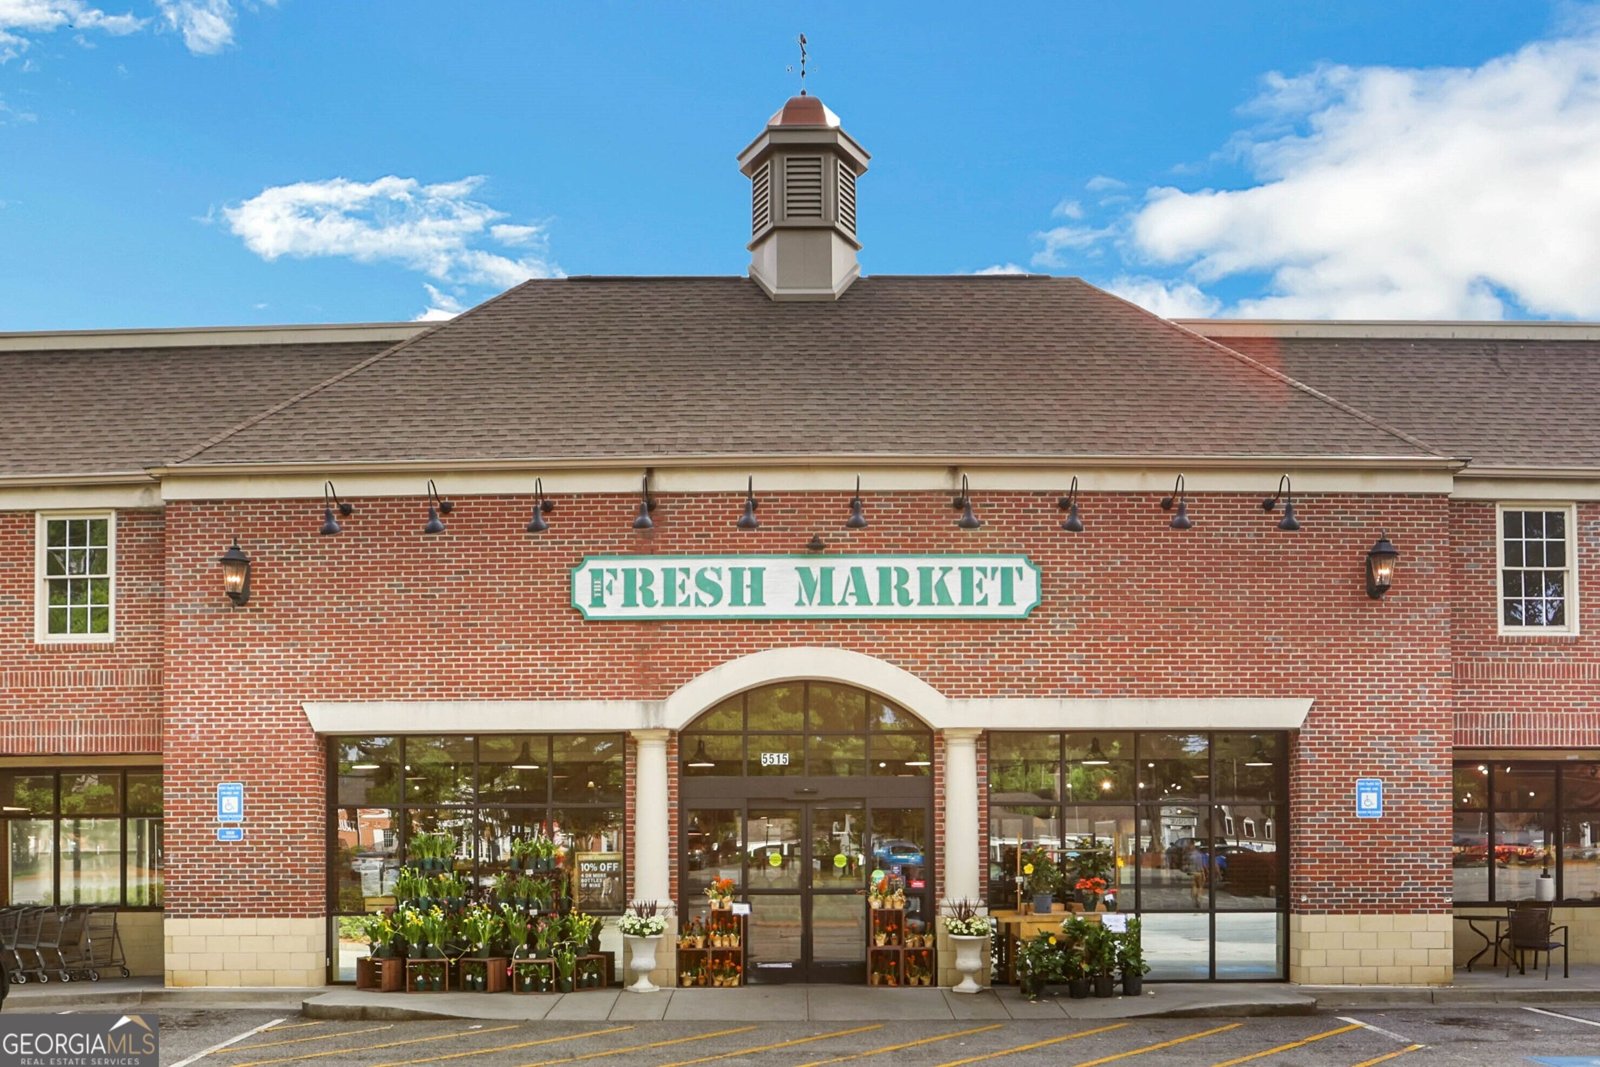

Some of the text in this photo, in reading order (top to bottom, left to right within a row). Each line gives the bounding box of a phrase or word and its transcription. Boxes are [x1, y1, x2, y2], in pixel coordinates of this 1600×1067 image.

[588, 566, 1023, 608] FRESH MARKET
[762, 753, 788, 764] 5515
[580, 862, 619, 872] 10% OFF
